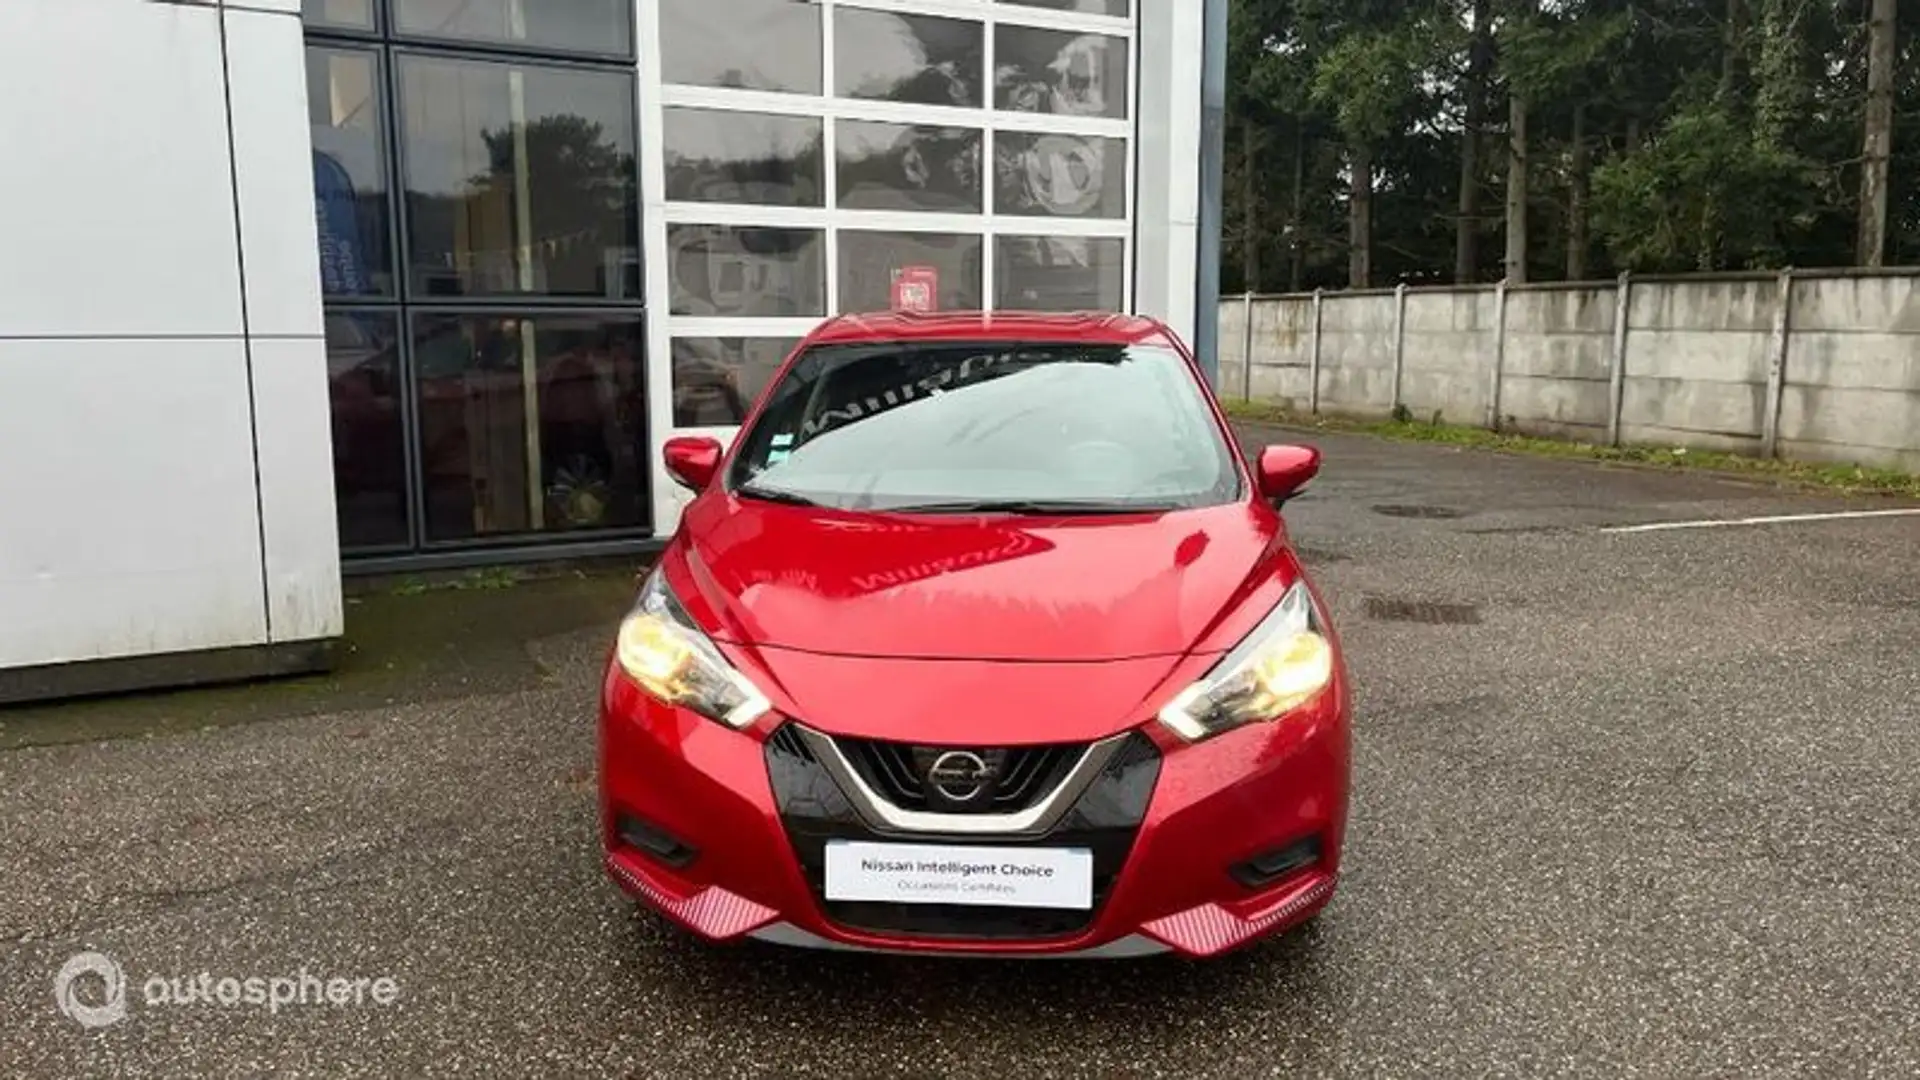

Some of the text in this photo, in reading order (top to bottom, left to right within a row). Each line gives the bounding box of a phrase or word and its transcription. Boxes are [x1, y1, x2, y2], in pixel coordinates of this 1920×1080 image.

[861, 859, 1055, 878] Nissan Intelligent Choice
